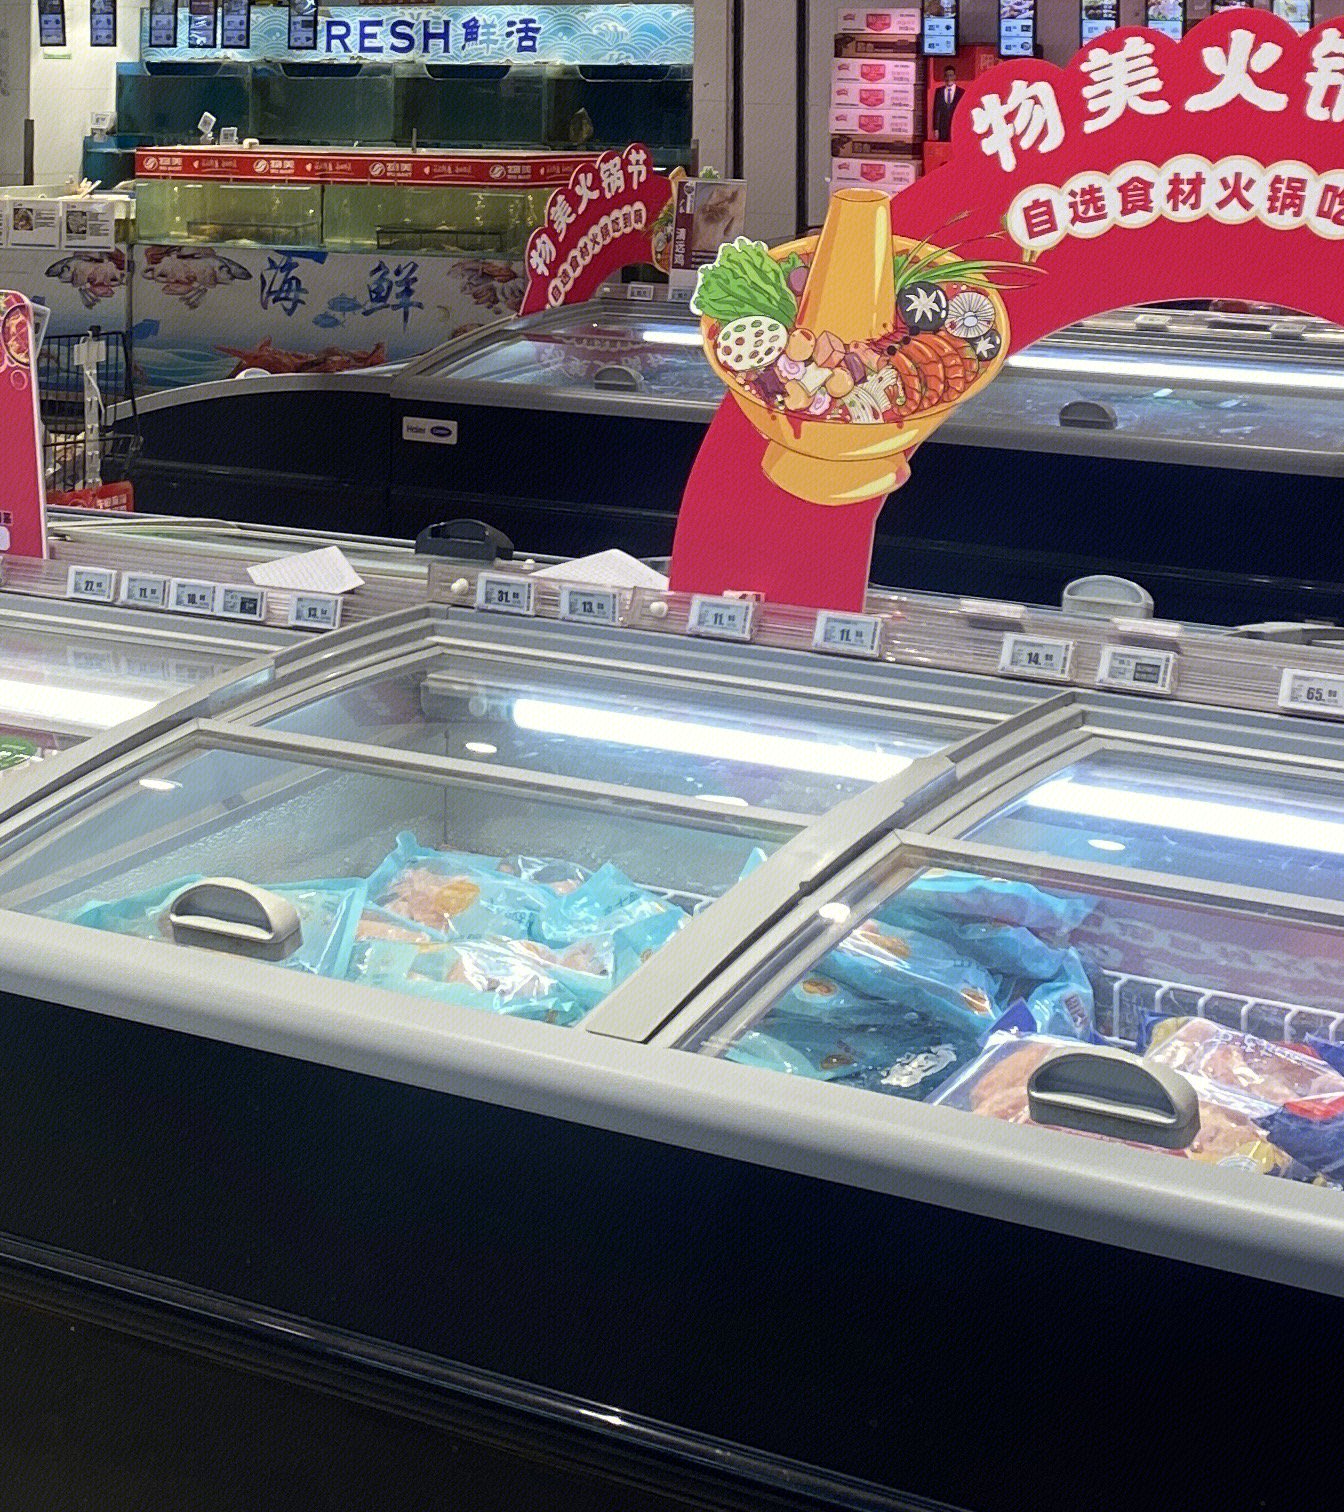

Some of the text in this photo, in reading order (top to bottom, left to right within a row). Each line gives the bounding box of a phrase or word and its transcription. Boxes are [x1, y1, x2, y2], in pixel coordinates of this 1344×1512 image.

[324, 18, 452, 54] RESH
[462, 16, 542, 54] 鲜活
[529, 149, 647, 277] 物美火锅节
[259, 254, 424, 330] 海鲜
